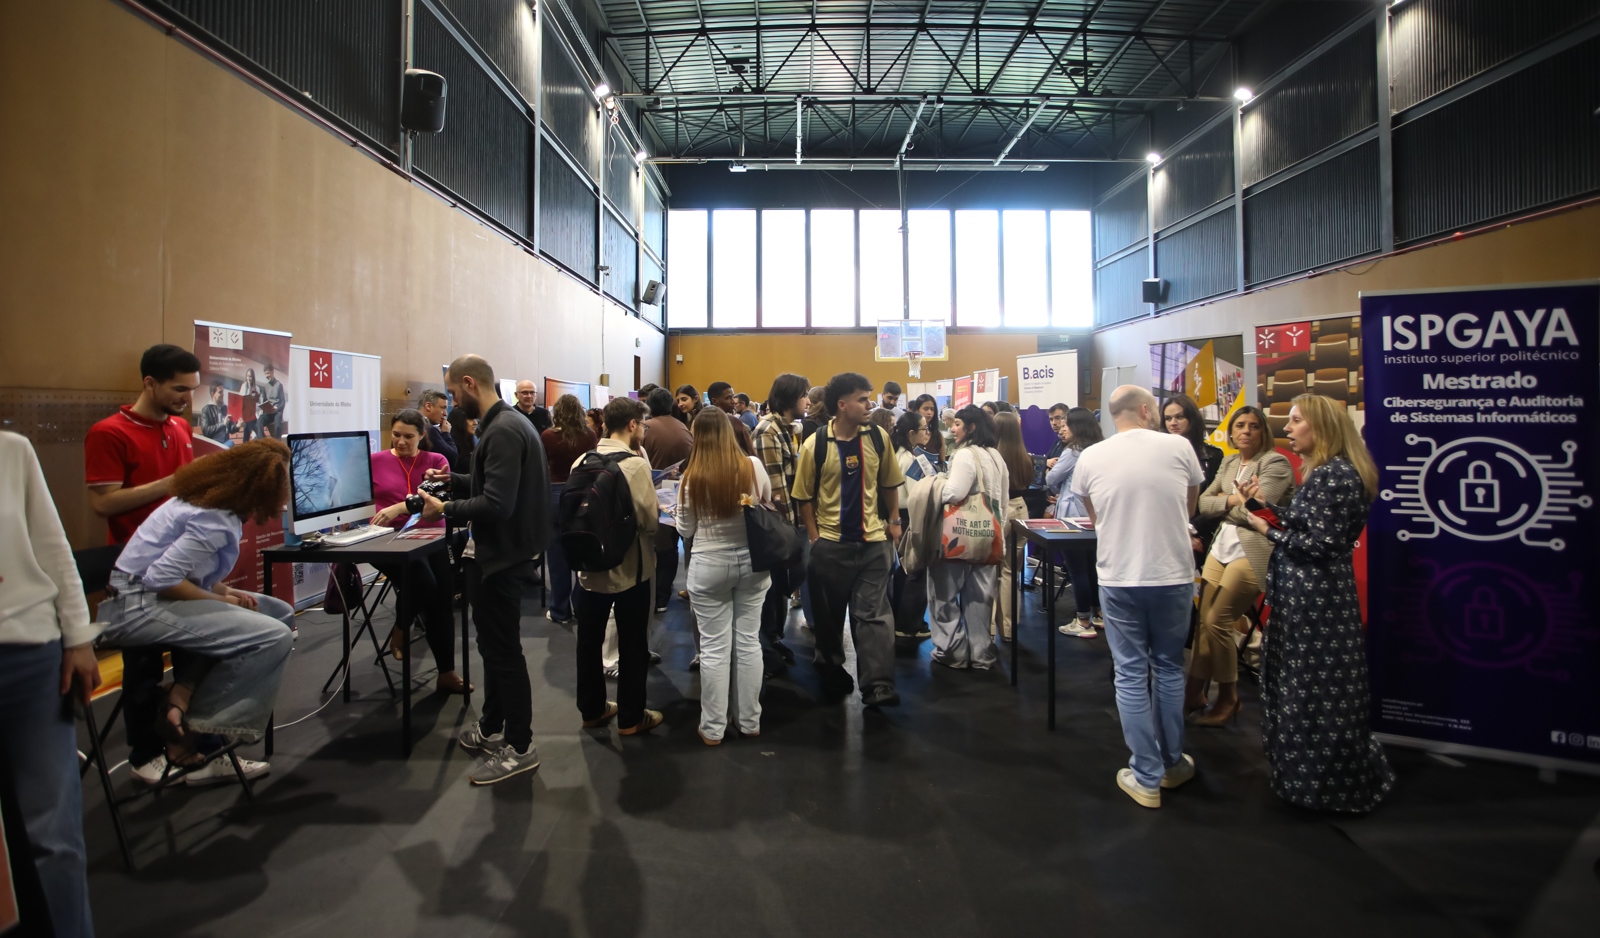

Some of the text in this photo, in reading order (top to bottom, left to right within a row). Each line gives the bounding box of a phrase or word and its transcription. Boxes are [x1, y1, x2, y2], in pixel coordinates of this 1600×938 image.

[1382, 308, 1579, 351] ISPGAYA
[1384, 350, 1579, 365] instituto superior politécnico
[1023, 365, 1054, 380] B.acis
[1423, 371, 1537, 390] Mestrado
[1383, 395, 1583, 410] Cibersegurança e Auditoria
[1390, 411, 1577, 424] de Sistemas Informáticos
[956, 518, 991, 528] THE ART OF
[952, 527, 995, 538] MOTHERHOOD
